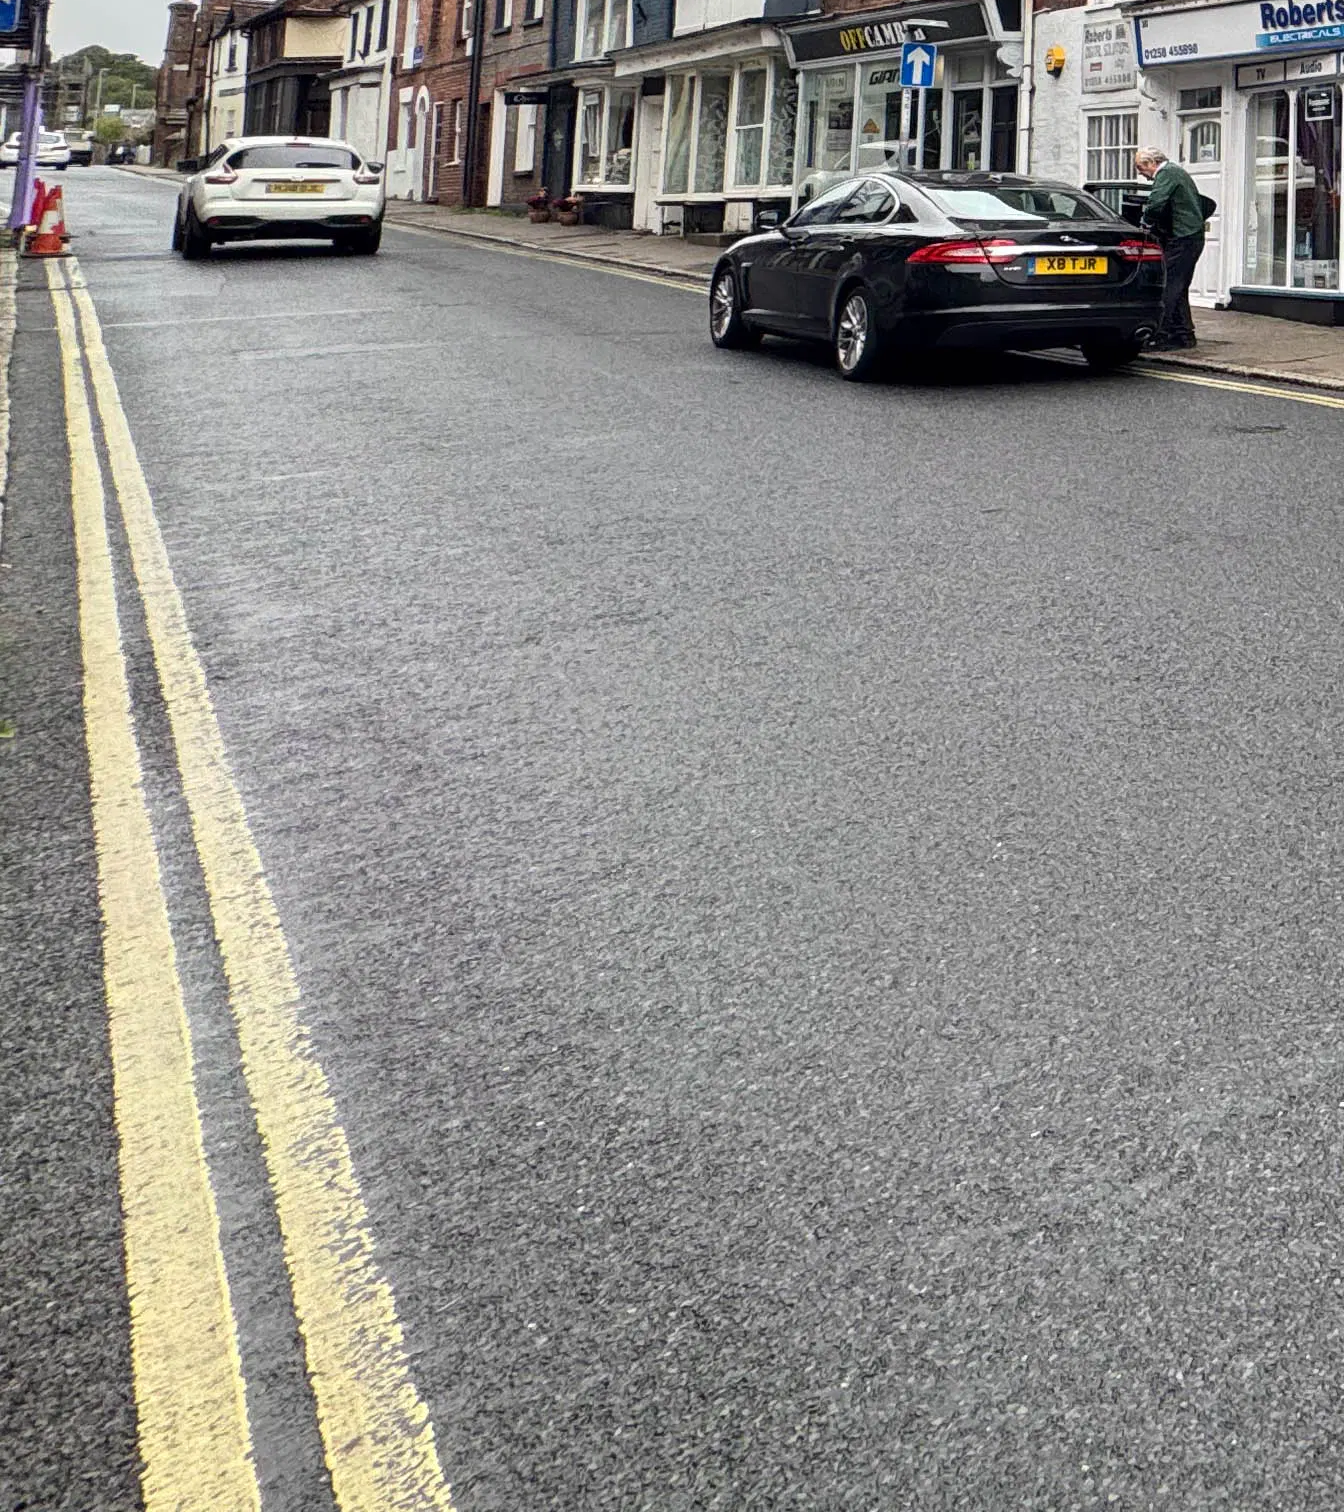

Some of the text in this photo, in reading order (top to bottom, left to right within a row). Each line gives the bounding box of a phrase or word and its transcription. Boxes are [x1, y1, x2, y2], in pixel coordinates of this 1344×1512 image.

[1269, 27, 1341, 43] ELECTRICALS
[1300, 60, 1322, 74] Audio
[869, 68, 901, 85] GIAN
[1256, 69, 1266, 80] TV
[1068, 258, 1097, 271] TJR
